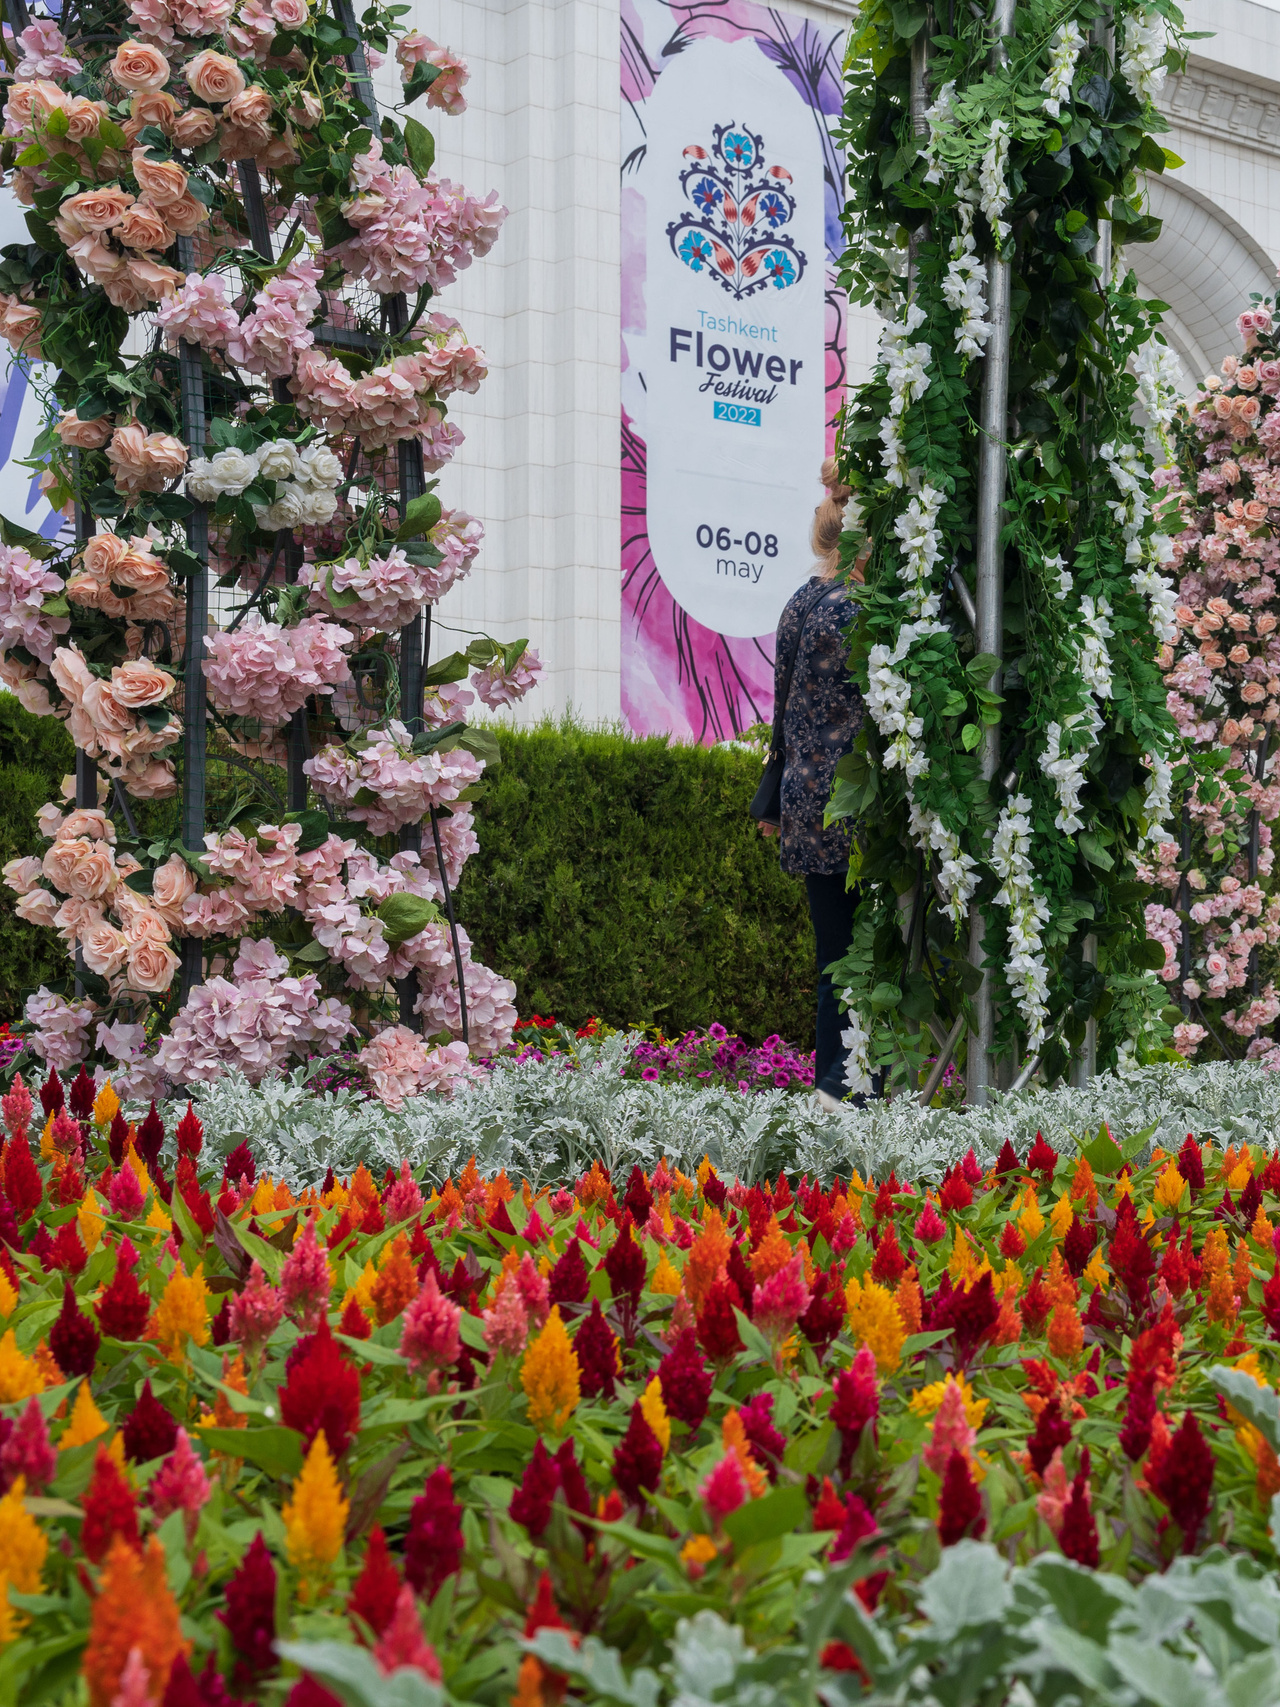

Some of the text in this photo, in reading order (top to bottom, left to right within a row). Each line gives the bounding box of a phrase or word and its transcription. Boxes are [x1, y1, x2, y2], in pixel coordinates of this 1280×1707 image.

[697, 309, 778, 343] Tashkent
[670, 327, 803, 385] Flower
[698, 371, 778, 405] Festival
[717, 403, 757, 425] 2022
[696, 523, 779, 558] 06-08
[716, 558, 764, 584] may
